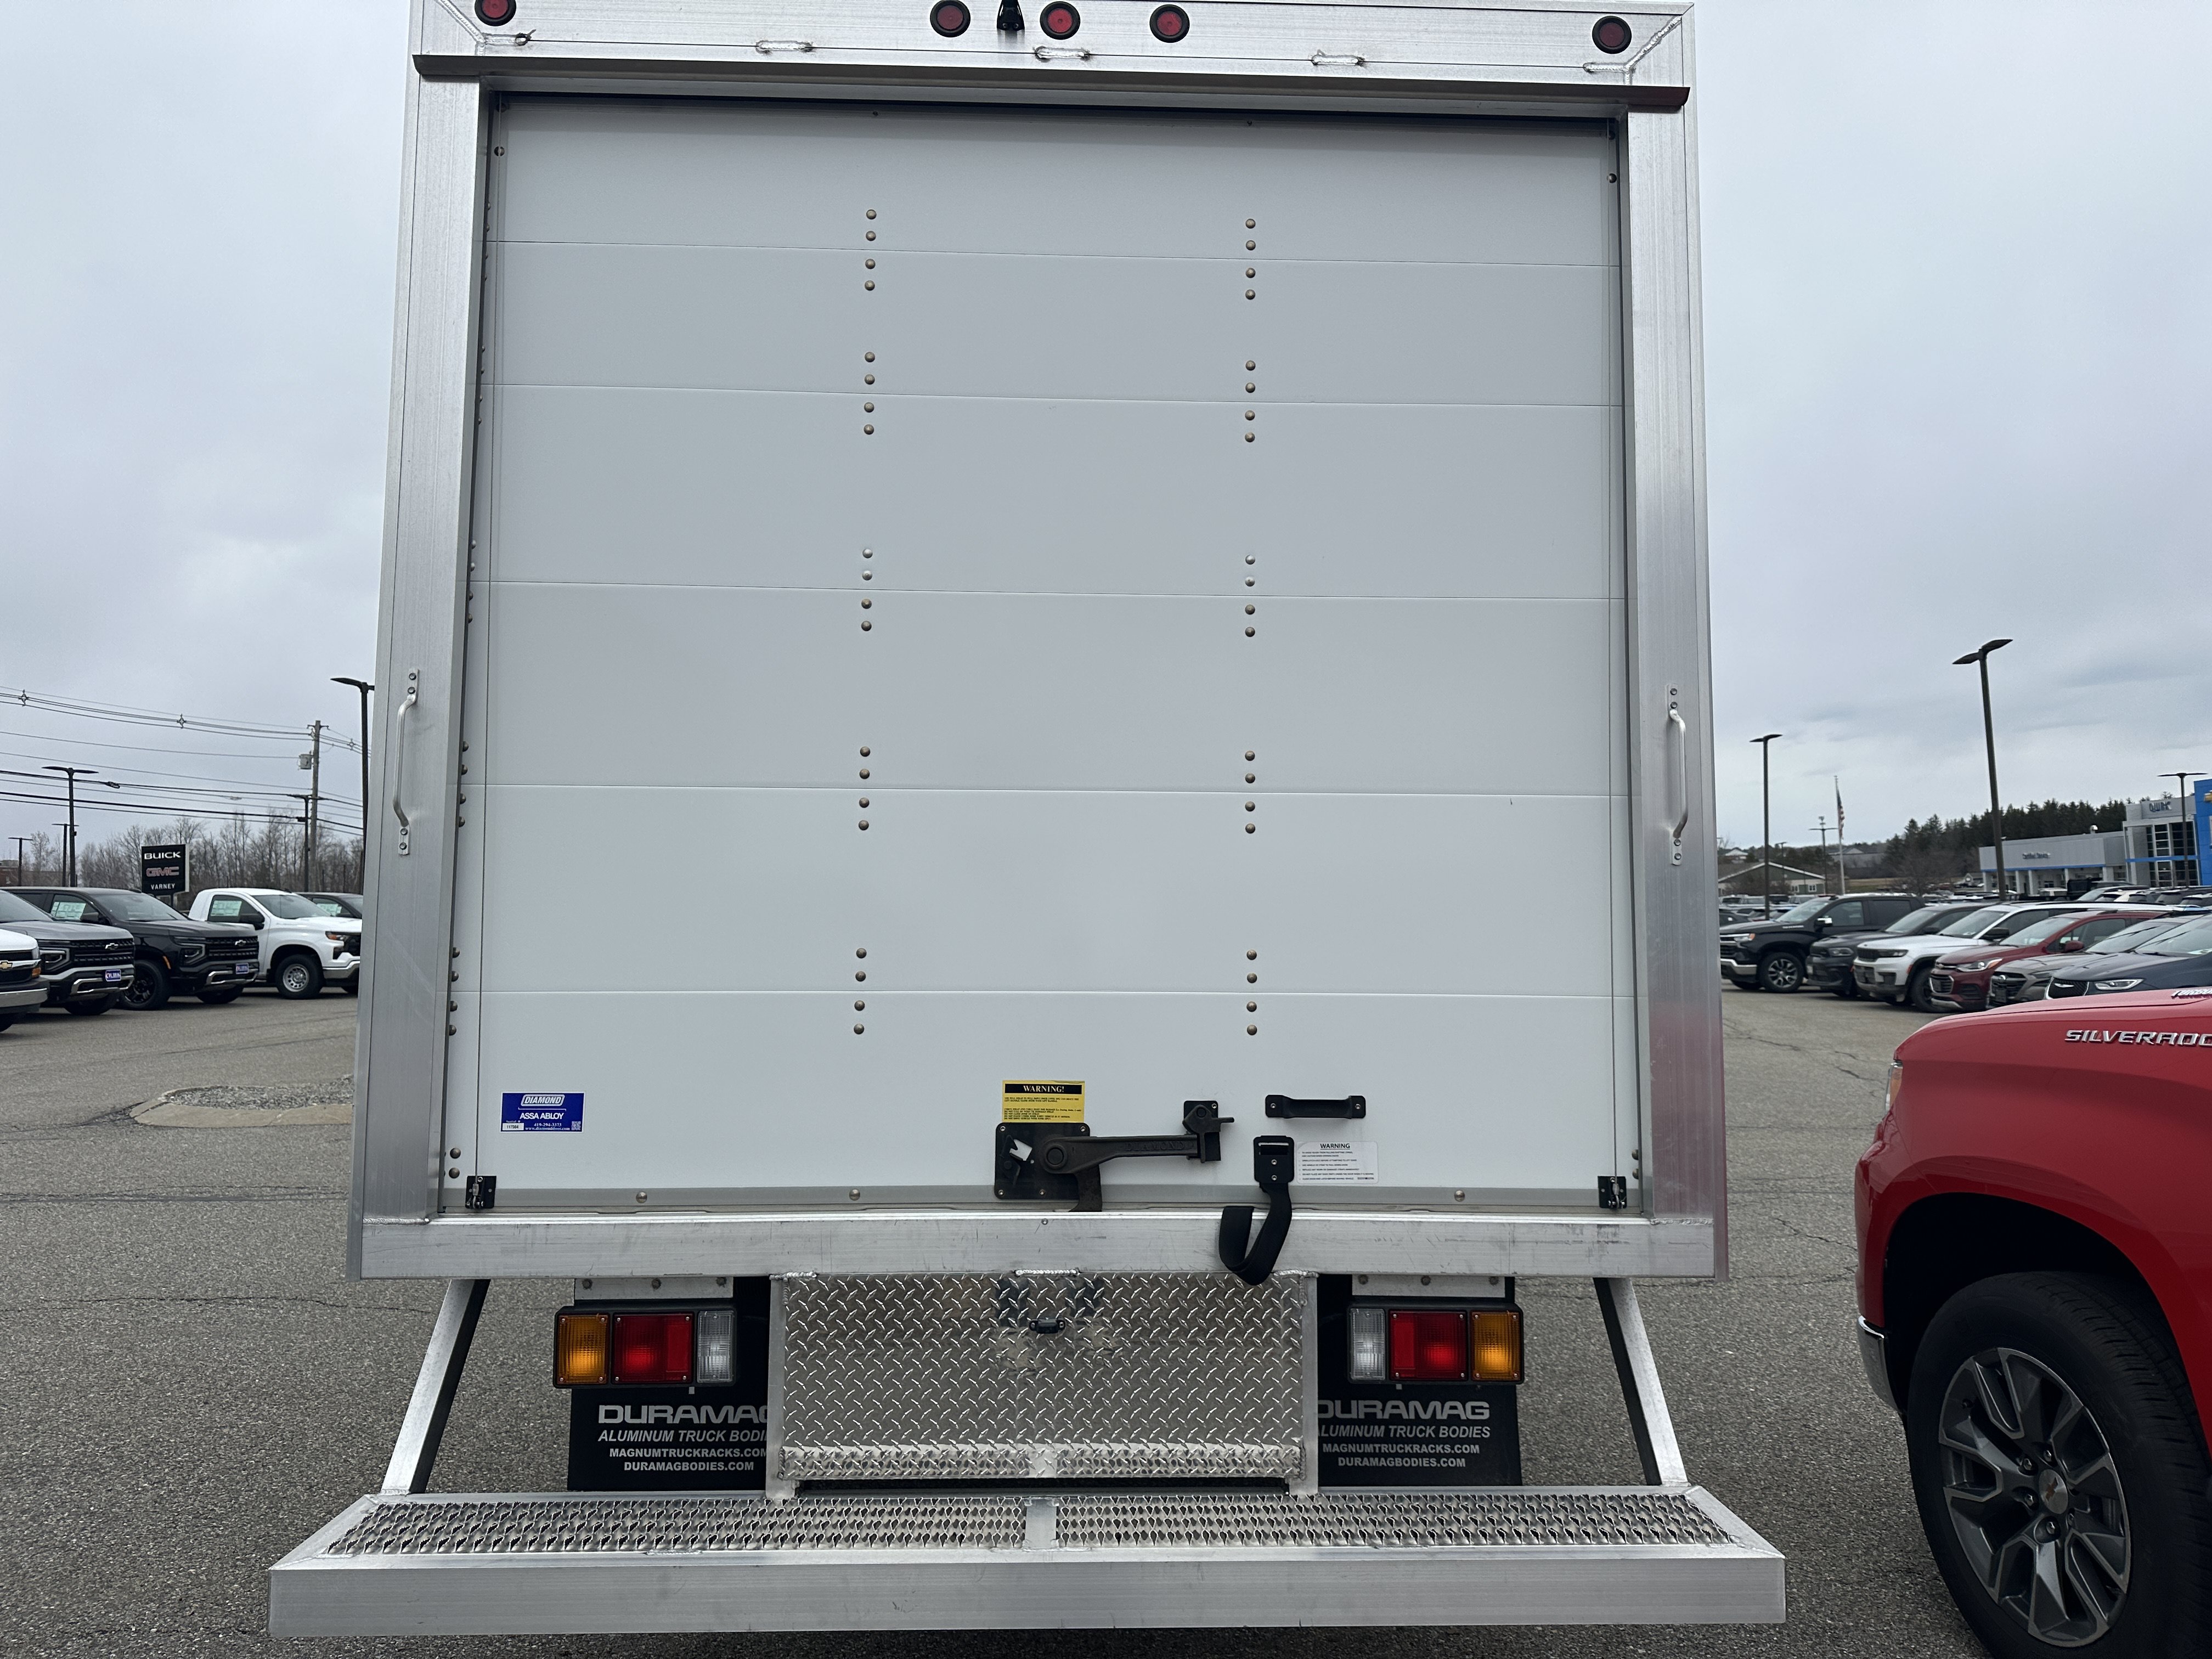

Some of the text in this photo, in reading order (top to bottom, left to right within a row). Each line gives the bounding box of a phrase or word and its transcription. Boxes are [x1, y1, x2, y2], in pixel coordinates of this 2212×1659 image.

[144, 851, 181, 860] BUICK
[146, 866, 179, 877] GMC
[524, 1096, 561, 1104] DIAMOND
[1318, 1400, 1490, 1420] DURAMAG
[598, 1430, 767, 1442] ALUMINUM TRUCK BODI
[1318, 1425, 1491, 1438] LUMINUM TRUCK BODIES
[1323, 1443, 1480, 1454] MAGNUMTRUCKRACKS.COM
[624, 1462, 754, 1471] DURAMAGBODIES.COM
[1338, 1457, 1466, 1468] DURAMAGBODIES.COM
